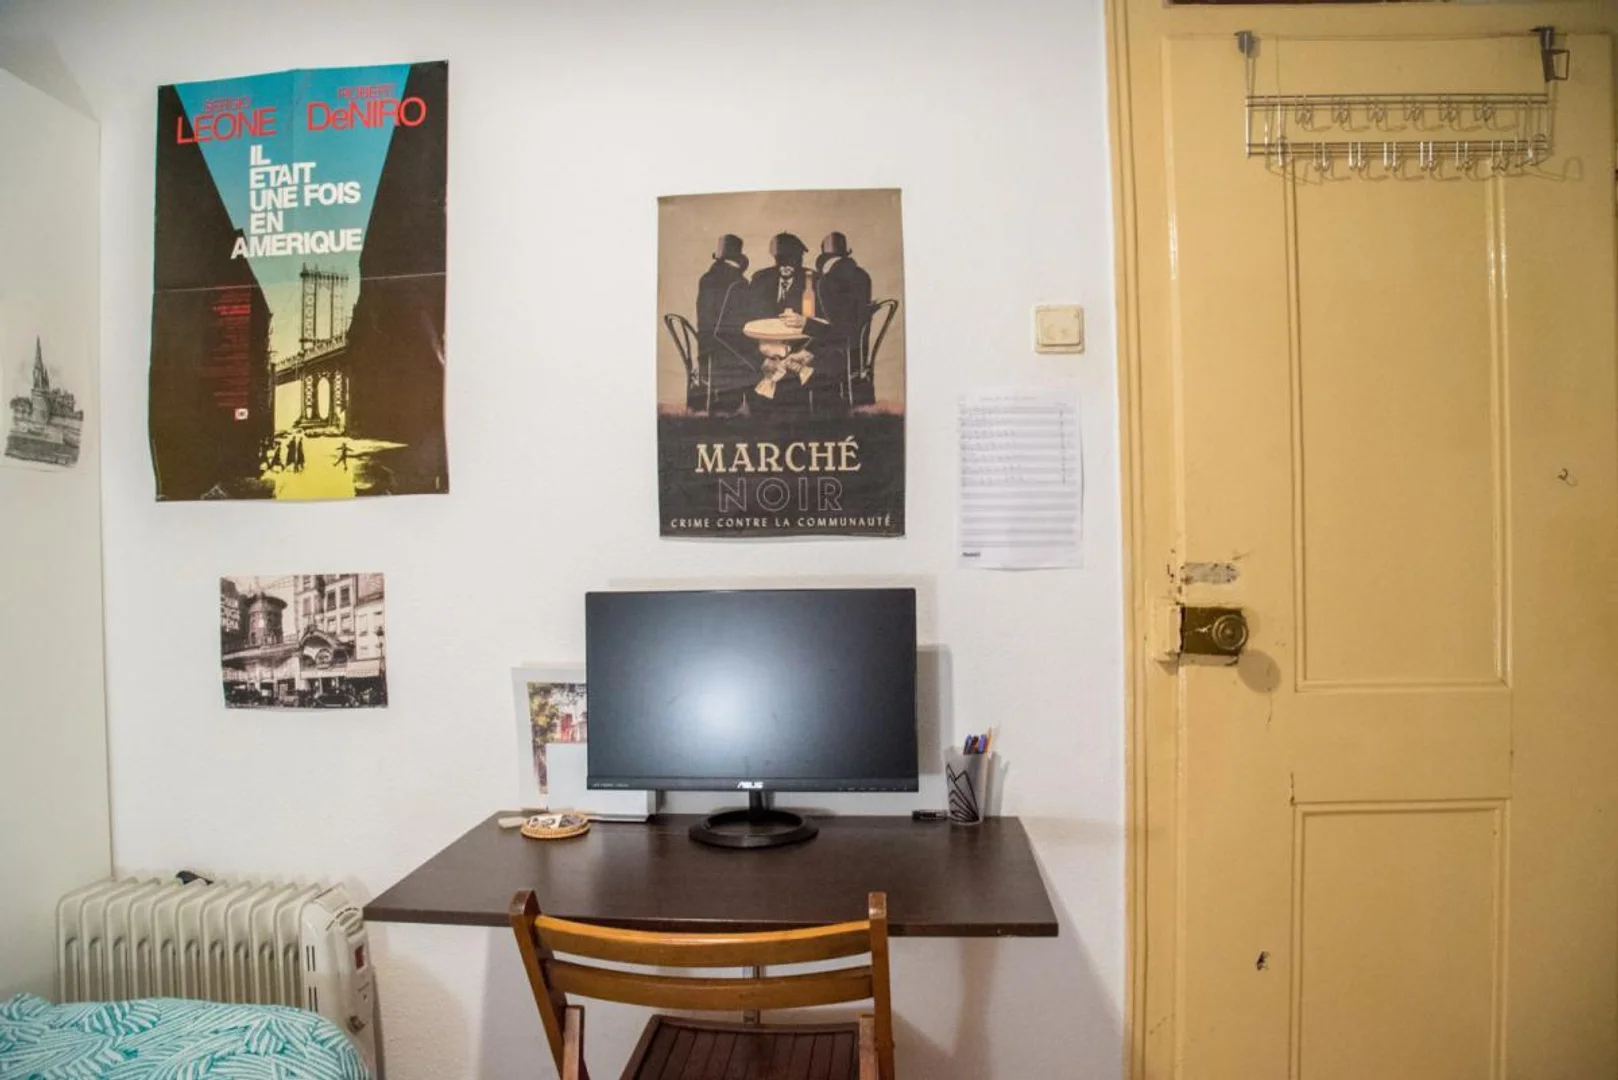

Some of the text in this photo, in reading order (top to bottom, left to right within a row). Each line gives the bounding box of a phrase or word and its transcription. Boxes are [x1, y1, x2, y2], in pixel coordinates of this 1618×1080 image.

[204, 95, 250, 112] SERGIO
[338, 84, 396, 99] ROBERT
[176, 107, 277, 144] LEONE
[306, 97, 427, 131] DeNIRO
[250, 144, 271, 165] IL
[250, 162, 316, 188] ETAIT
[250, 181, 361, 211] UNE FOIS
[250, 210, 284, 234] EN
[230, 228, 363, 259] AMERIQUE
[695, 435, 862, 473] MARCHÉ
[718, 476, 843, 512] NOIR
[670, 514, 892, 528] CRIME CONTRE LA COMMUNAUTÉ
[737, 781, 764, 789] ASUS
